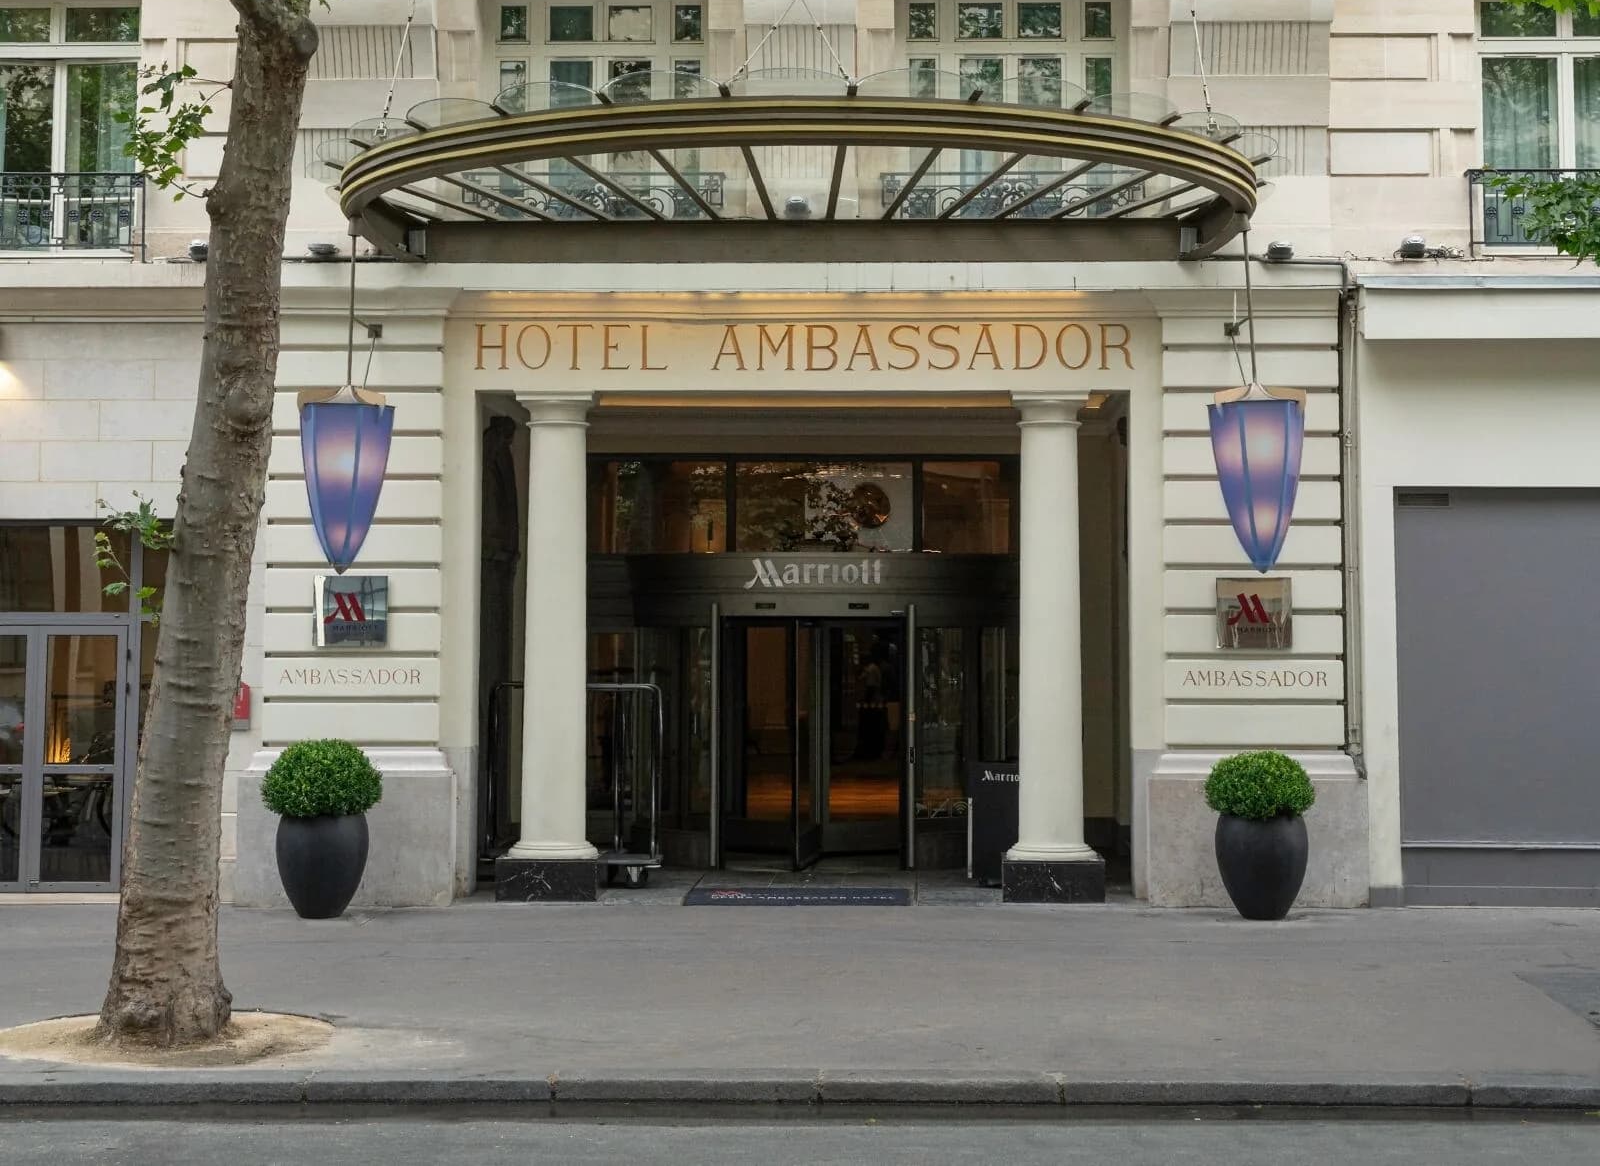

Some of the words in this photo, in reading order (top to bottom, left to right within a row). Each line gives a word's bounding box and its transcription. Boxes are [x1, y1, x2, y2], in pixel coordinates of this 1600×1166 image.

[474, 323, 669, 371] HOTEL
[711, 322, 1135, 371] AMBASSADOR
[743, 558, 882, 590] Marriott
[279, 668, 422, 685] AMBASSADOR
[1182, 670, 1328, 688] AMBASSADOR
